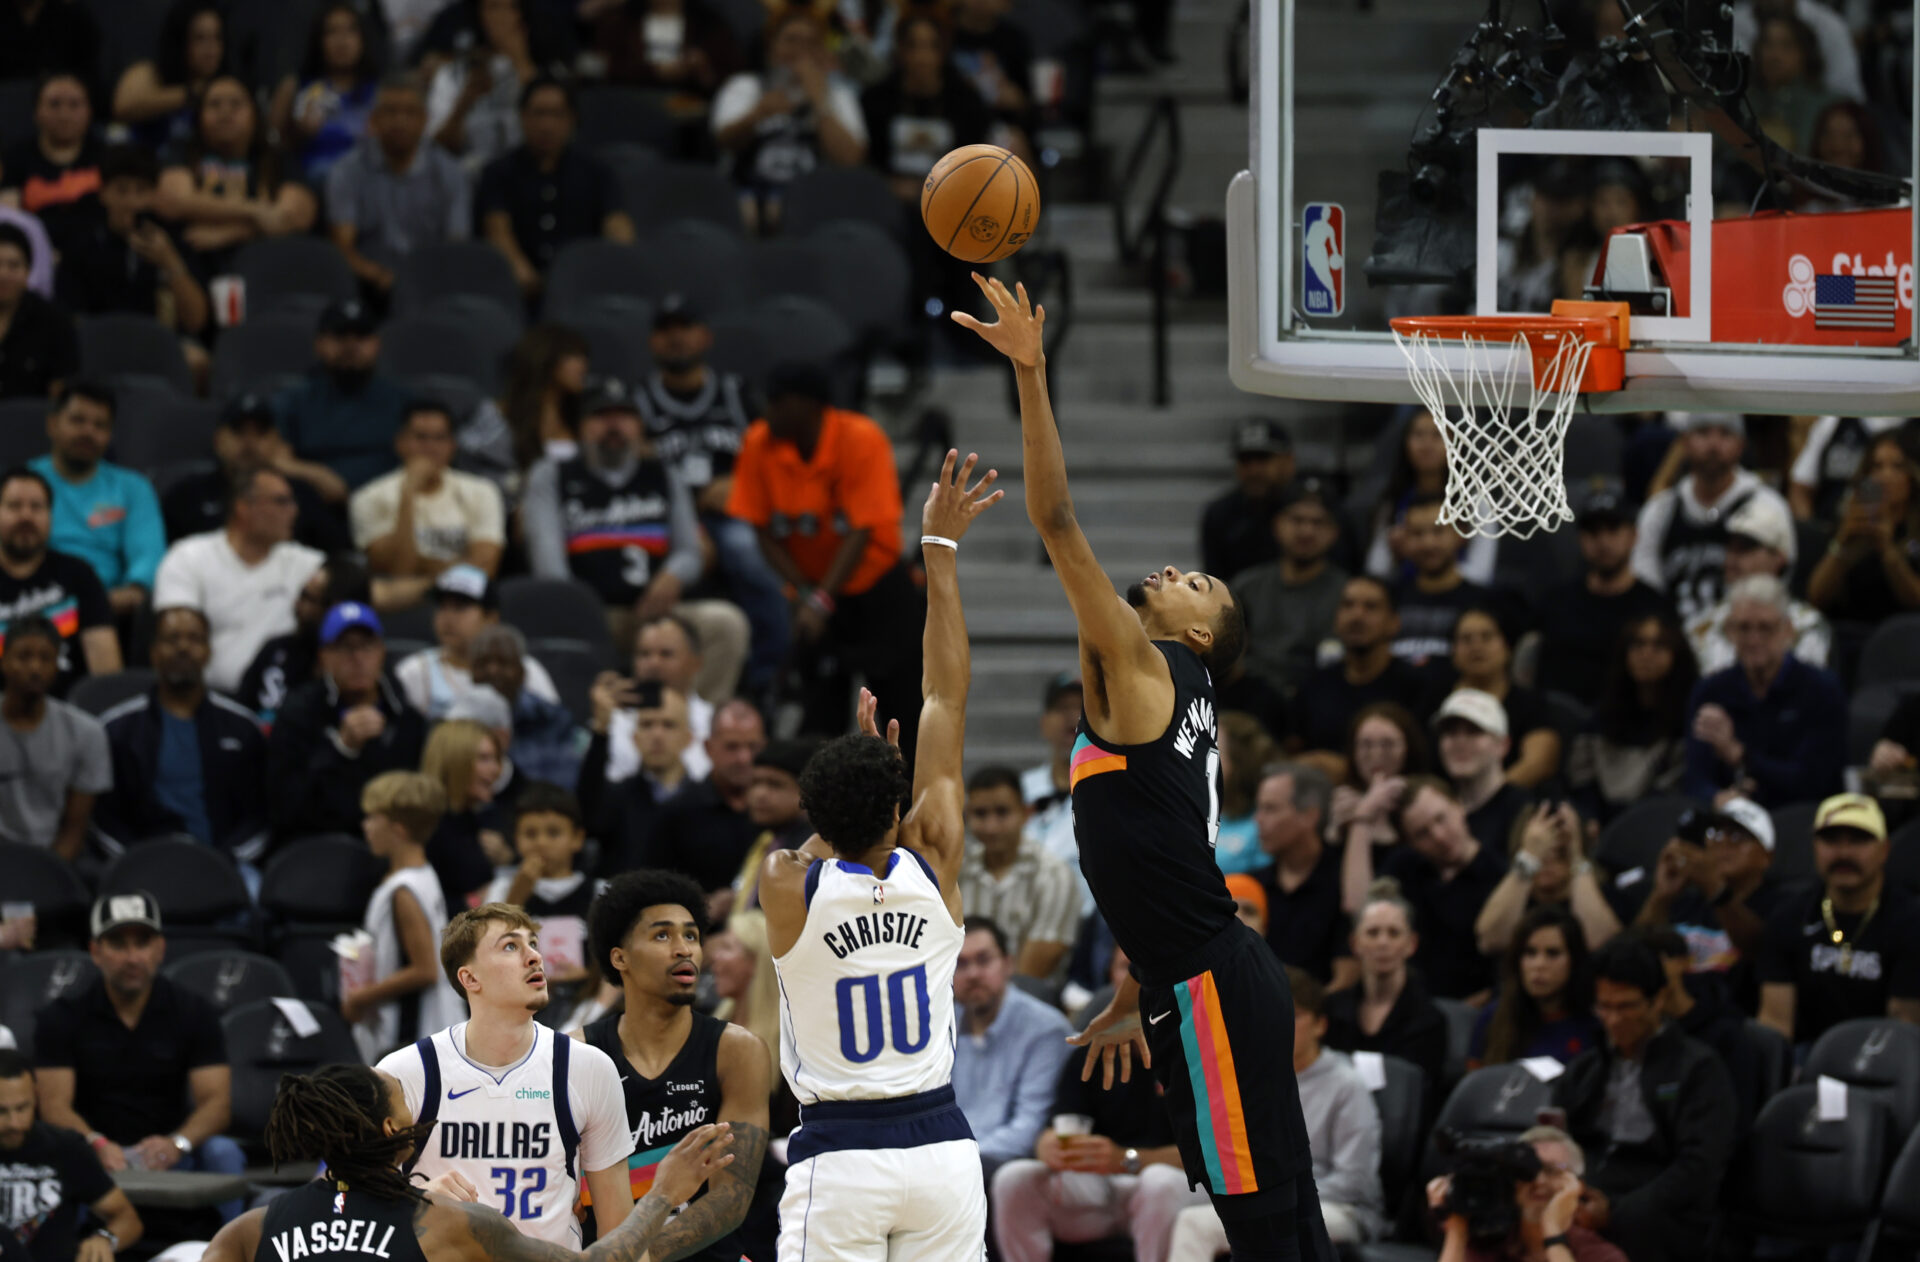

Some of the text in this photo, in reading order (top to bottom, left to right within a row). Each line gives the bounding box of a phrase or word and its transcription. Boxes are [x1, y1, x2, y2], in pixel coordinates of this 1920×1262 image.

[1308, 290, 1329, 309] NBA
[1205, 747, 1220, 849] 1
[823, 912, 928, 959] CHRISTIE
[836, 963, 931, 1064] 00
[515, 1087, 550, 1100] chime
[670, 1082, 701, 1093] LEDGER
[440, 1121, 550, 1159] DALLAS
[632, 1100, 709, 1146] Antonio
[491, 1167, 547, 1220] 32
[271, 1219, 395, 1262] VASSELL
